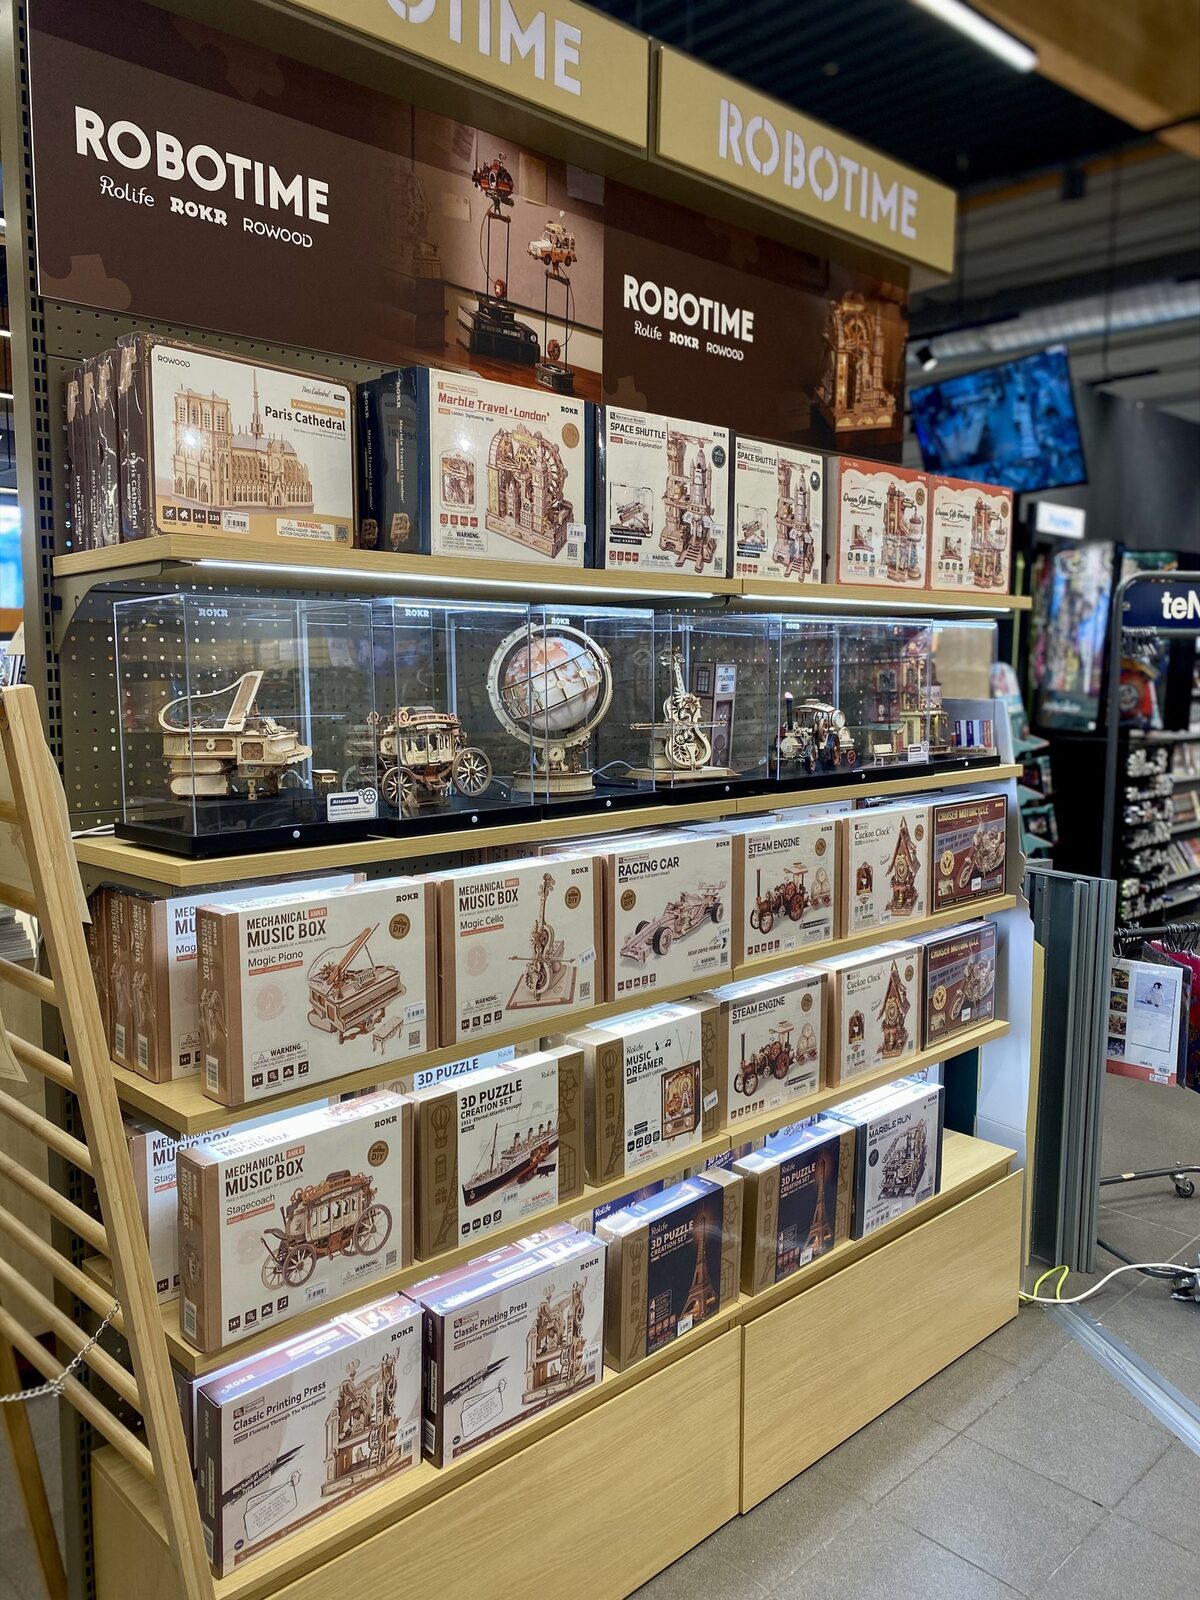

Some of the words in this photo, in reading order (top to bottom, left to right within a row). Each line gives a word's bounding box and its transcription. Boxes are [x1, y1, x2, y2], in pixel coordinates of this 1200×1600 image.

[74, 106, 330, 225] ROBOTIME
[718, 99, 918, 241] ROBOTIME
[99, 175, 155, 208] Rolife
[169, 196, 228, 228] ROKR
[243, 217, 314, 249] ROWOOD
[623, 274, 754, 344] ROBOTIME
[634, 320, 663, 342] Rolife
[669, 330, 700, 351] ROKR
[706, 341, 745, 362] ROWOOD
[157, 354, 191, 368] ROWOOD
[438, 392, 475, 409] Marble
[477, 399, 508, 416] Travel
[513, 407, 547, 423] London
[560, 405, 579, 416] ROKR
[265, 405, 293, 422] Paris
[295, 412, 346, 432] Cathedral
[610, 422, 634, 434] SPACE
[635, 426, 666, 440] SHUTTLE
[624, 438, 637, 446] Space
[638, 441, 663, 450] Exploration
[737, 451, 755, 462] SPACE
[755, 454, 778, 467] SHUTTLE
[208, 514, 220, 522] 330
[456, 531, 479, 539] WARNING
[199, 607, 228, 618] ROKR
[405, 608, 430, 618] ROKR
[551, 617, 570, 625] ROKR
[855, 831, 875, 840] Cuckoo
[875, 826, 890, 837] Clock
[748, 840, 773, 854] STEAM
[773, 836, 800, 851] ENGINE
[571, 866, 589, 875] ROKR
[619, 859, 658, 878] RACING
[660, 856, 680, 870] CAR
[396, 892, 419, 903] ROKR
[459, 881, 505, 897] MECHANICAL
[459, 892, 495, 912] MUSIC
[497, 888, 519, 905] BOX
[246, 911, 308, 931] MECHANICAL
[460, 918, 484, 930] Magic
[485, 915, 504, 925] Cello
[247, 925, 295, 948] MUSIC
[298, 919, 327, 939] BOX
[247, 955, 277, 968] Magic
[278, 951, 304, 962] Piano
[847, 978, 867, 990] Cuckoo
[867, 972, 881, 984] Clock
[732, 1005, 758, 1020] STEAM
[758, 996, 785, 1012] ENGINE
[270, 1043, 301, 1057] WARNING
[626, 1050, 652, 1067] MUSIC
[418, 1072, 434, 1086] 3D
[436, 1058, 479, 1080] PUZZLE
[626, 1056, 664, 1077] DREAMER
[461, 1095, 476, 1110] 3D
[480, 1079, 523, 1104] PUZZLE
[460, 1101, 498, 1120] CREATION
[499, 1096, 513, 1107] SET
[506, 1102, 523, 1112] Voyager
[374, 1115, 398, 1129] ROKR
[868, 1119, 897, 1140] MARBLE
[897, 1112, 912, 1127] RUN
[225, 1152, 286, 1180] MECHANICAL
[372, 1153, 385, 1161] DIY
[225, 1168, 273, 1197] MUSIC
[276, 1157, 304, 1181] BOX
[781, 1176, 791, 1187] 3D
[791, 1162, 816, 1182] PUZZLE
[226, 1193, 276, 1216] Stagecoach
[651, 1221, 669, 1236] Rolife
[651, 1236, 663, 1250] 3D
[663, 1219, 694, 1244] PUZZLE
[650, 1239, 677, 1258] CREATION
[677, 1233, 688, 1244] SET
[580, 1257, 600, 1271] ROKR
[229, 1318, 241, 1327] 14+
[453, 1323, 479, 1340] Classic
[479, 1311, 508, 1328] Printing
[509, 1301, 528, 1315] Press
[391, 1325, 415, 1342] ROKR
[233, 1411, 265, 1431] Classic
[266, 1393, 302, 1416] Printing
[304, 1381, 327, 1397] Press
[270, 1413, 291, 1427] Through
[291, 1408, 301, 1416] The
